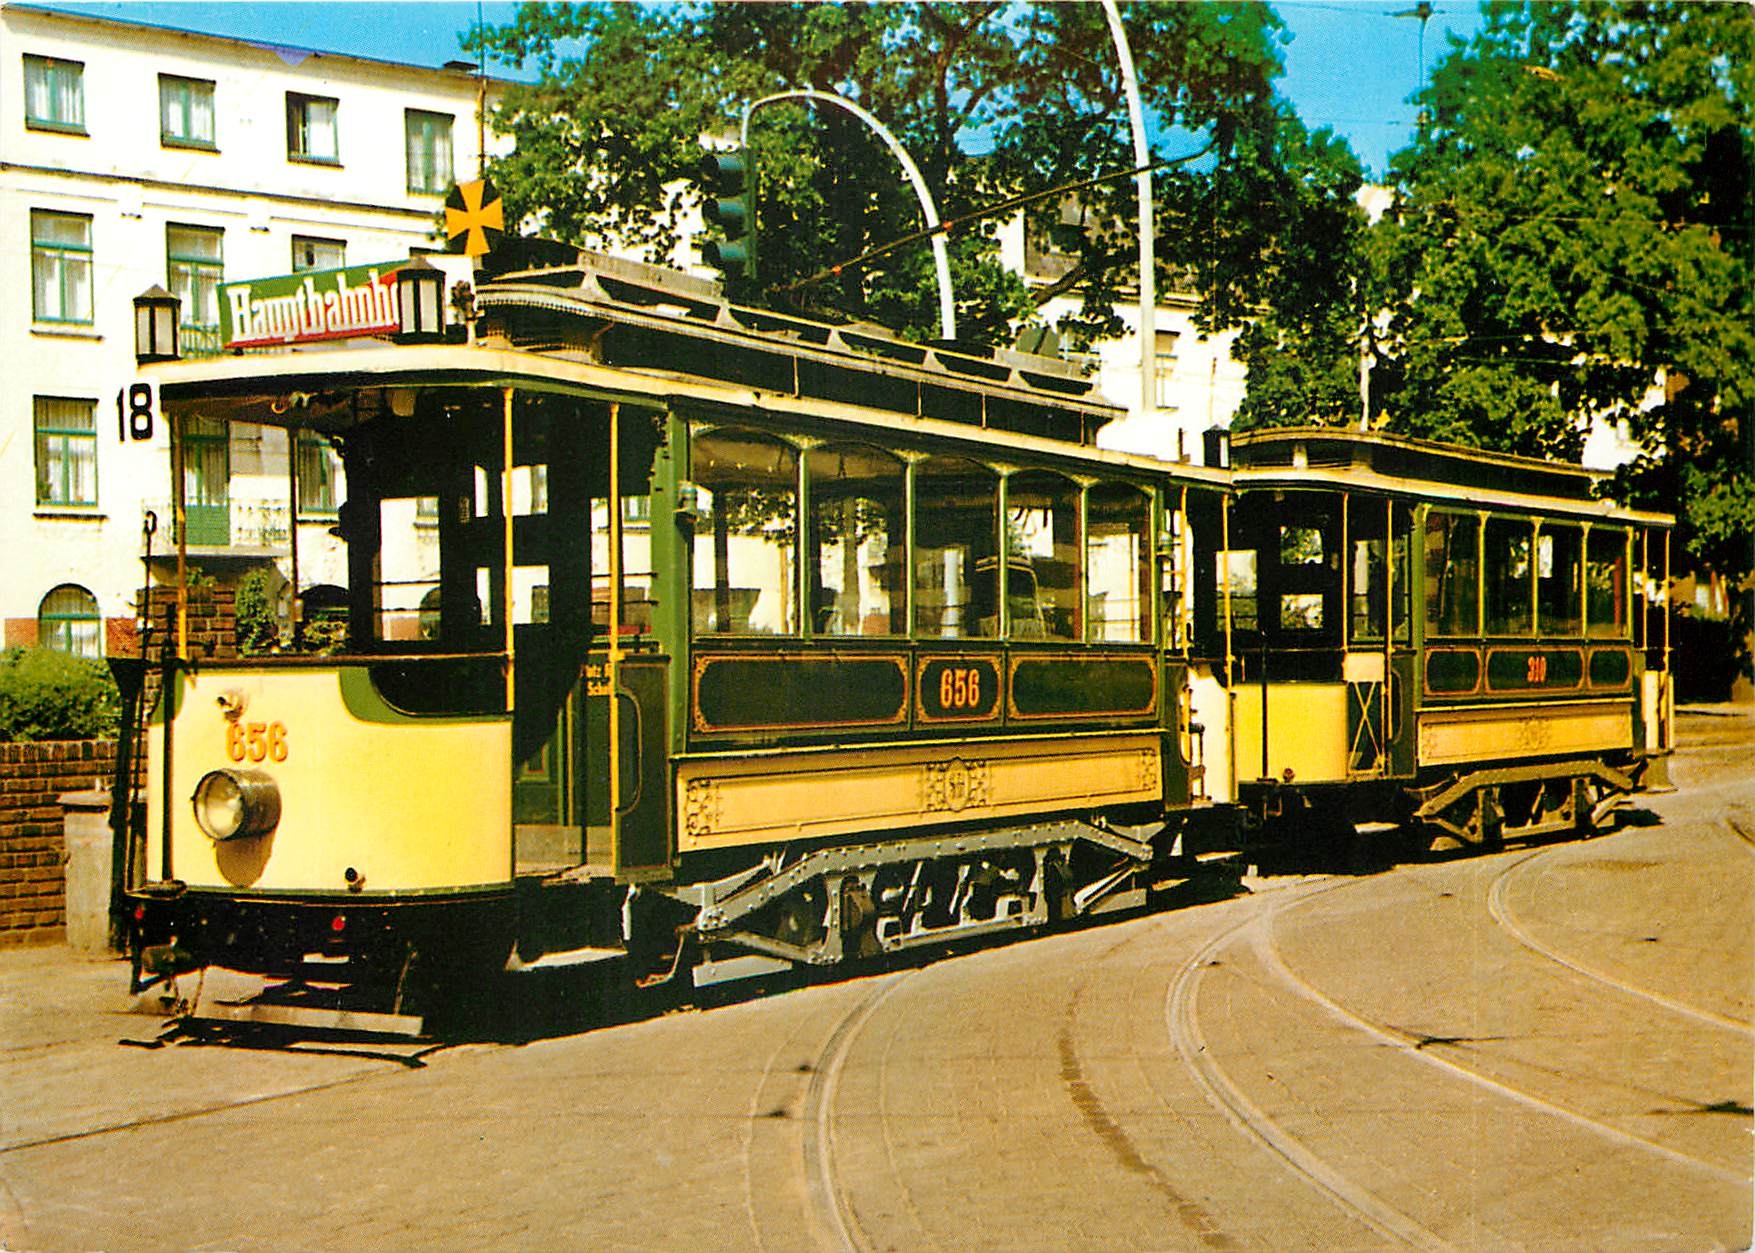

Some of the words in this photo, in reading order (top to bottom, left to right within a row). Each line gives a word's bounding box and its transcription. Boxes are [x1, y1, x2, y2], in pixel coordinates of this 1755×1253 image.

[116, 383, 153, 442] 18
[940, 668, 980, 708] 656
[226, 721, 288, 763] 656
